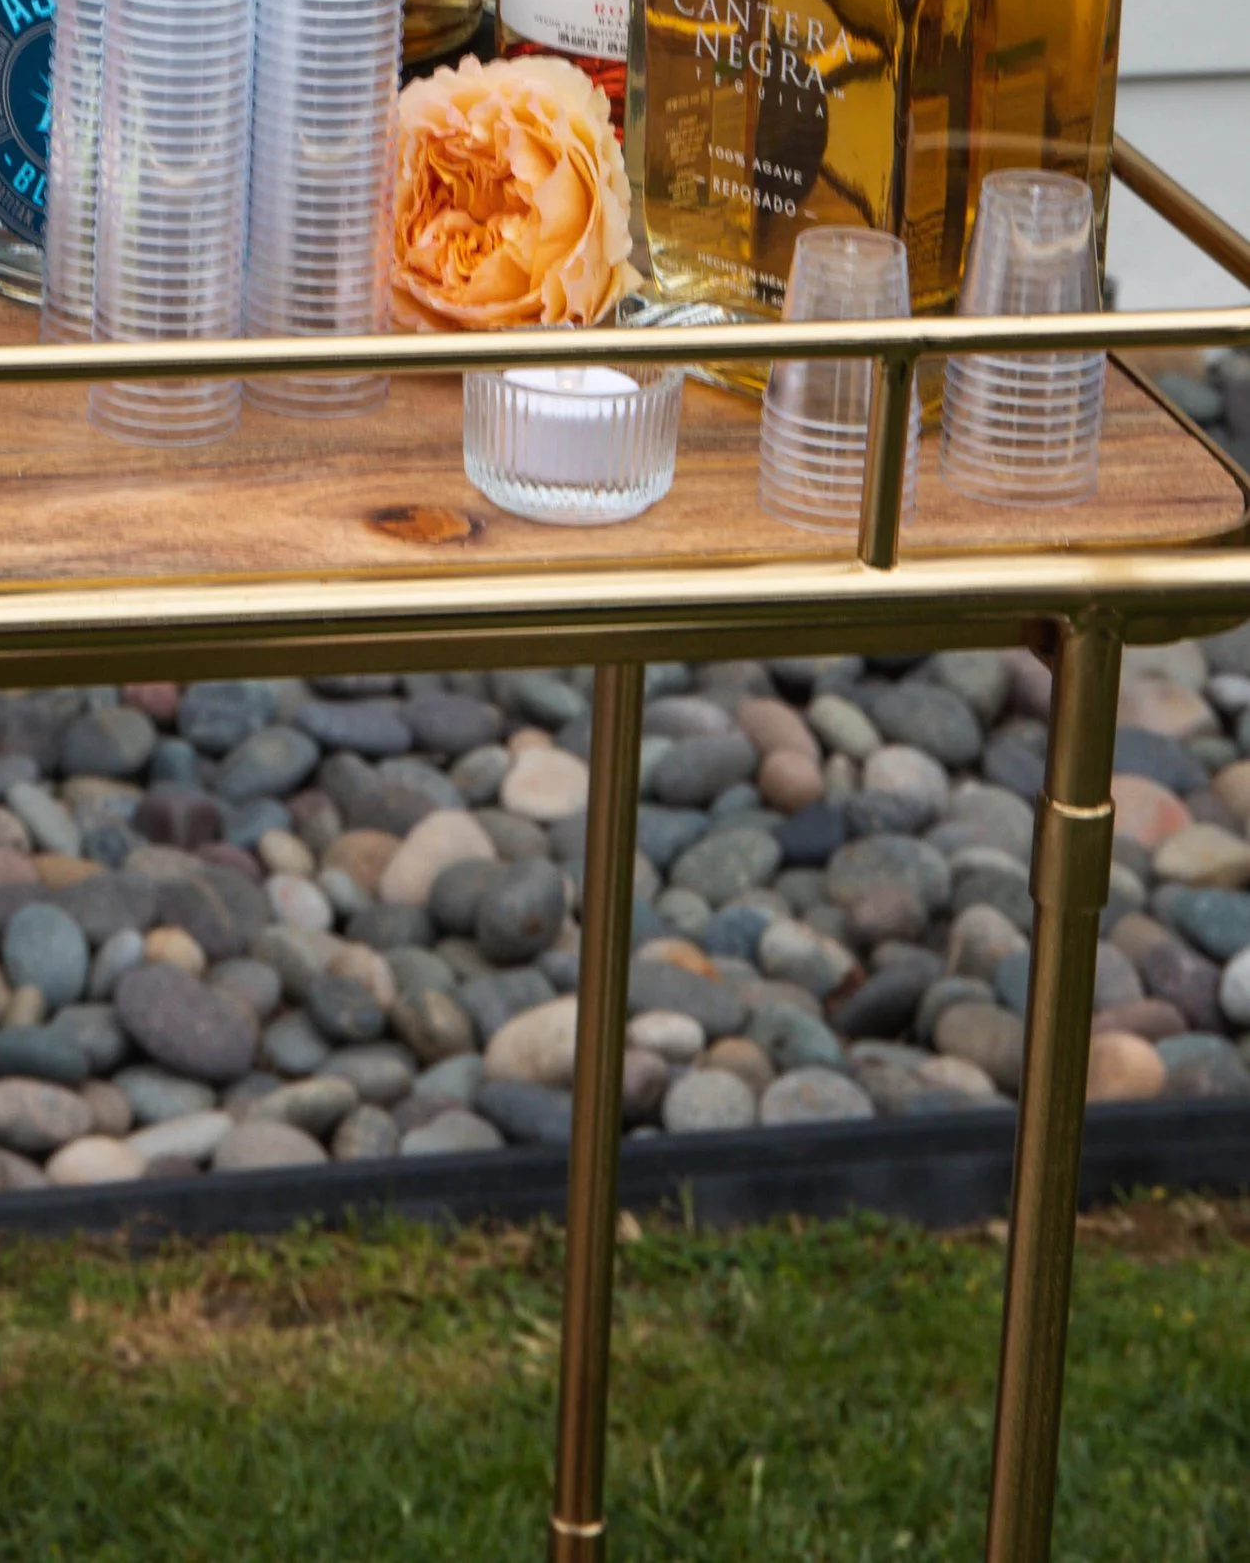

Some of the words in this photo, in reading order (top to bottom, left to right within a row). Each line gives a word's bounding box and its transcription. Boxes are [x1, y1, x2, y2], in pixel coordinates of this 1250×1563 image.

[695, 24, 827, 96] NEGRA
[695, 65, 825, 120] TEQUILA
[707, 142, 746, 169] 100%
[753, 156, 803, 186] AGAVE
[712, 175, 797, 219] REPOSADO
